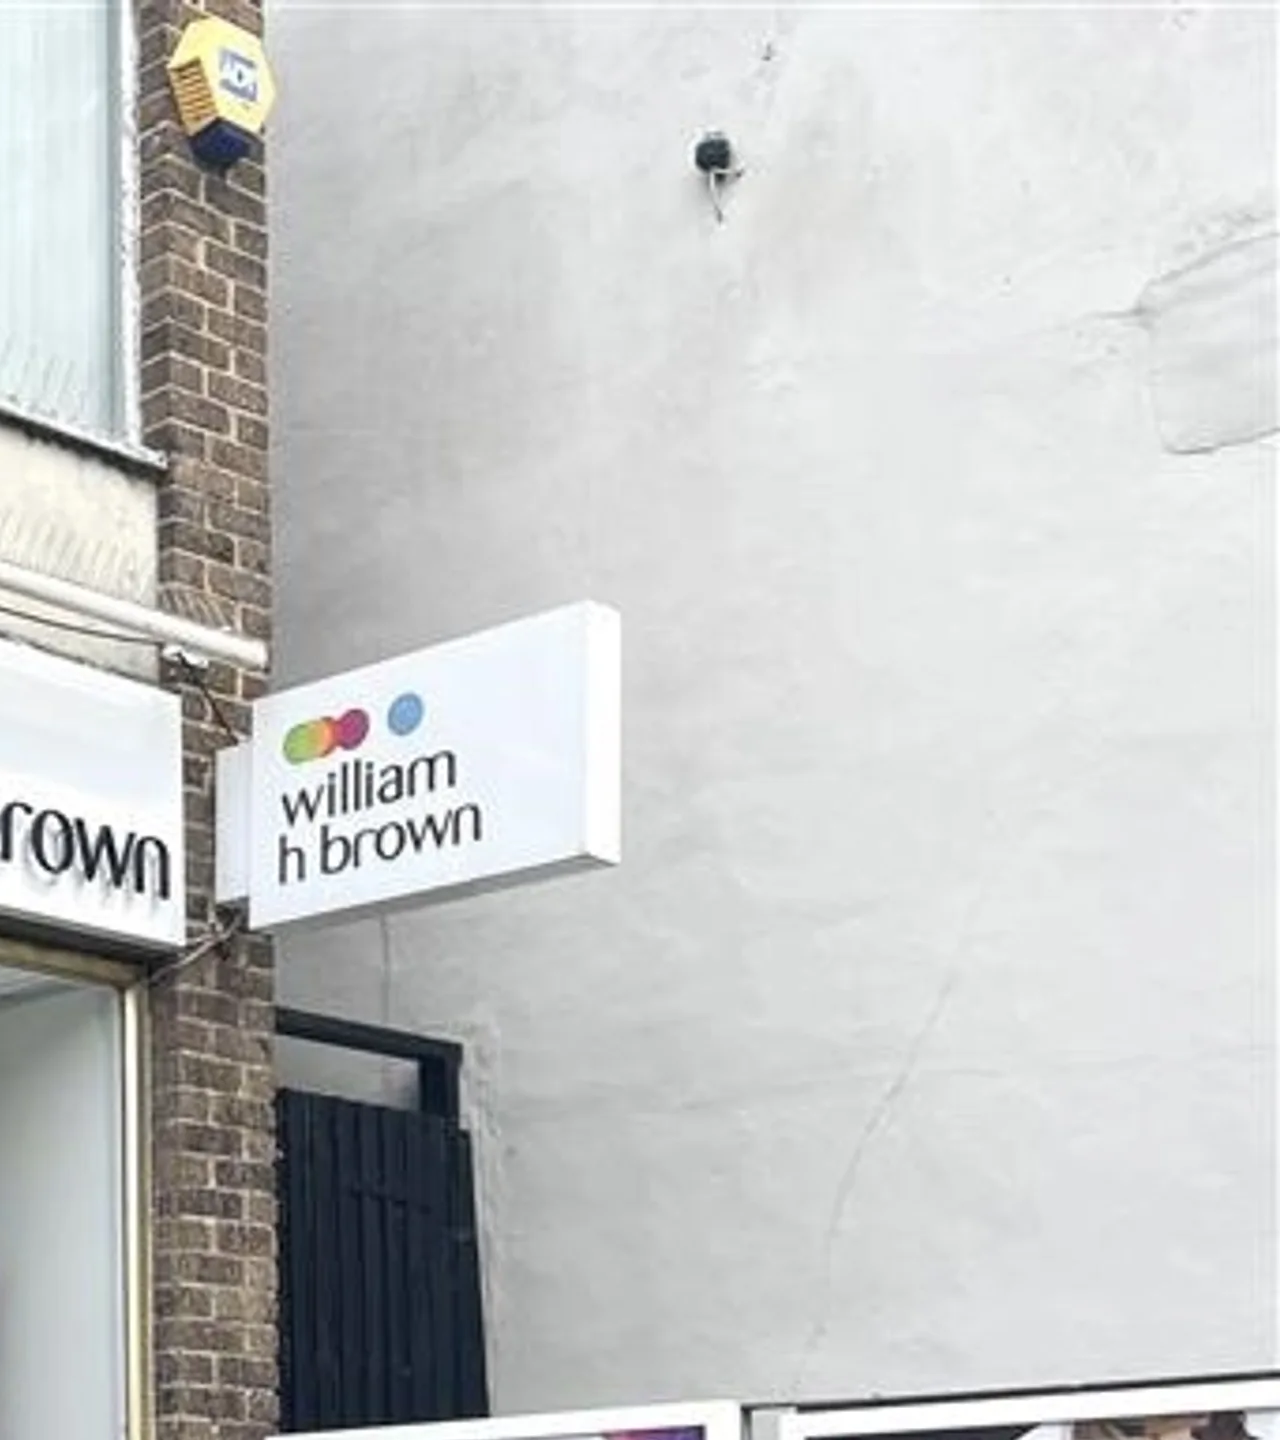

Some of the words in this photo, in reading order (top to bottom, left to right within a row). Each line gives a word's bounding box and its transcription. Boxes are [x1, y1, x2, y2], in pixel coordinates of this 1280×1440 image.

[281, 746, 459, 826] william
[276, 834, 306, 885] h
[318, 794, 485, 876] brown
